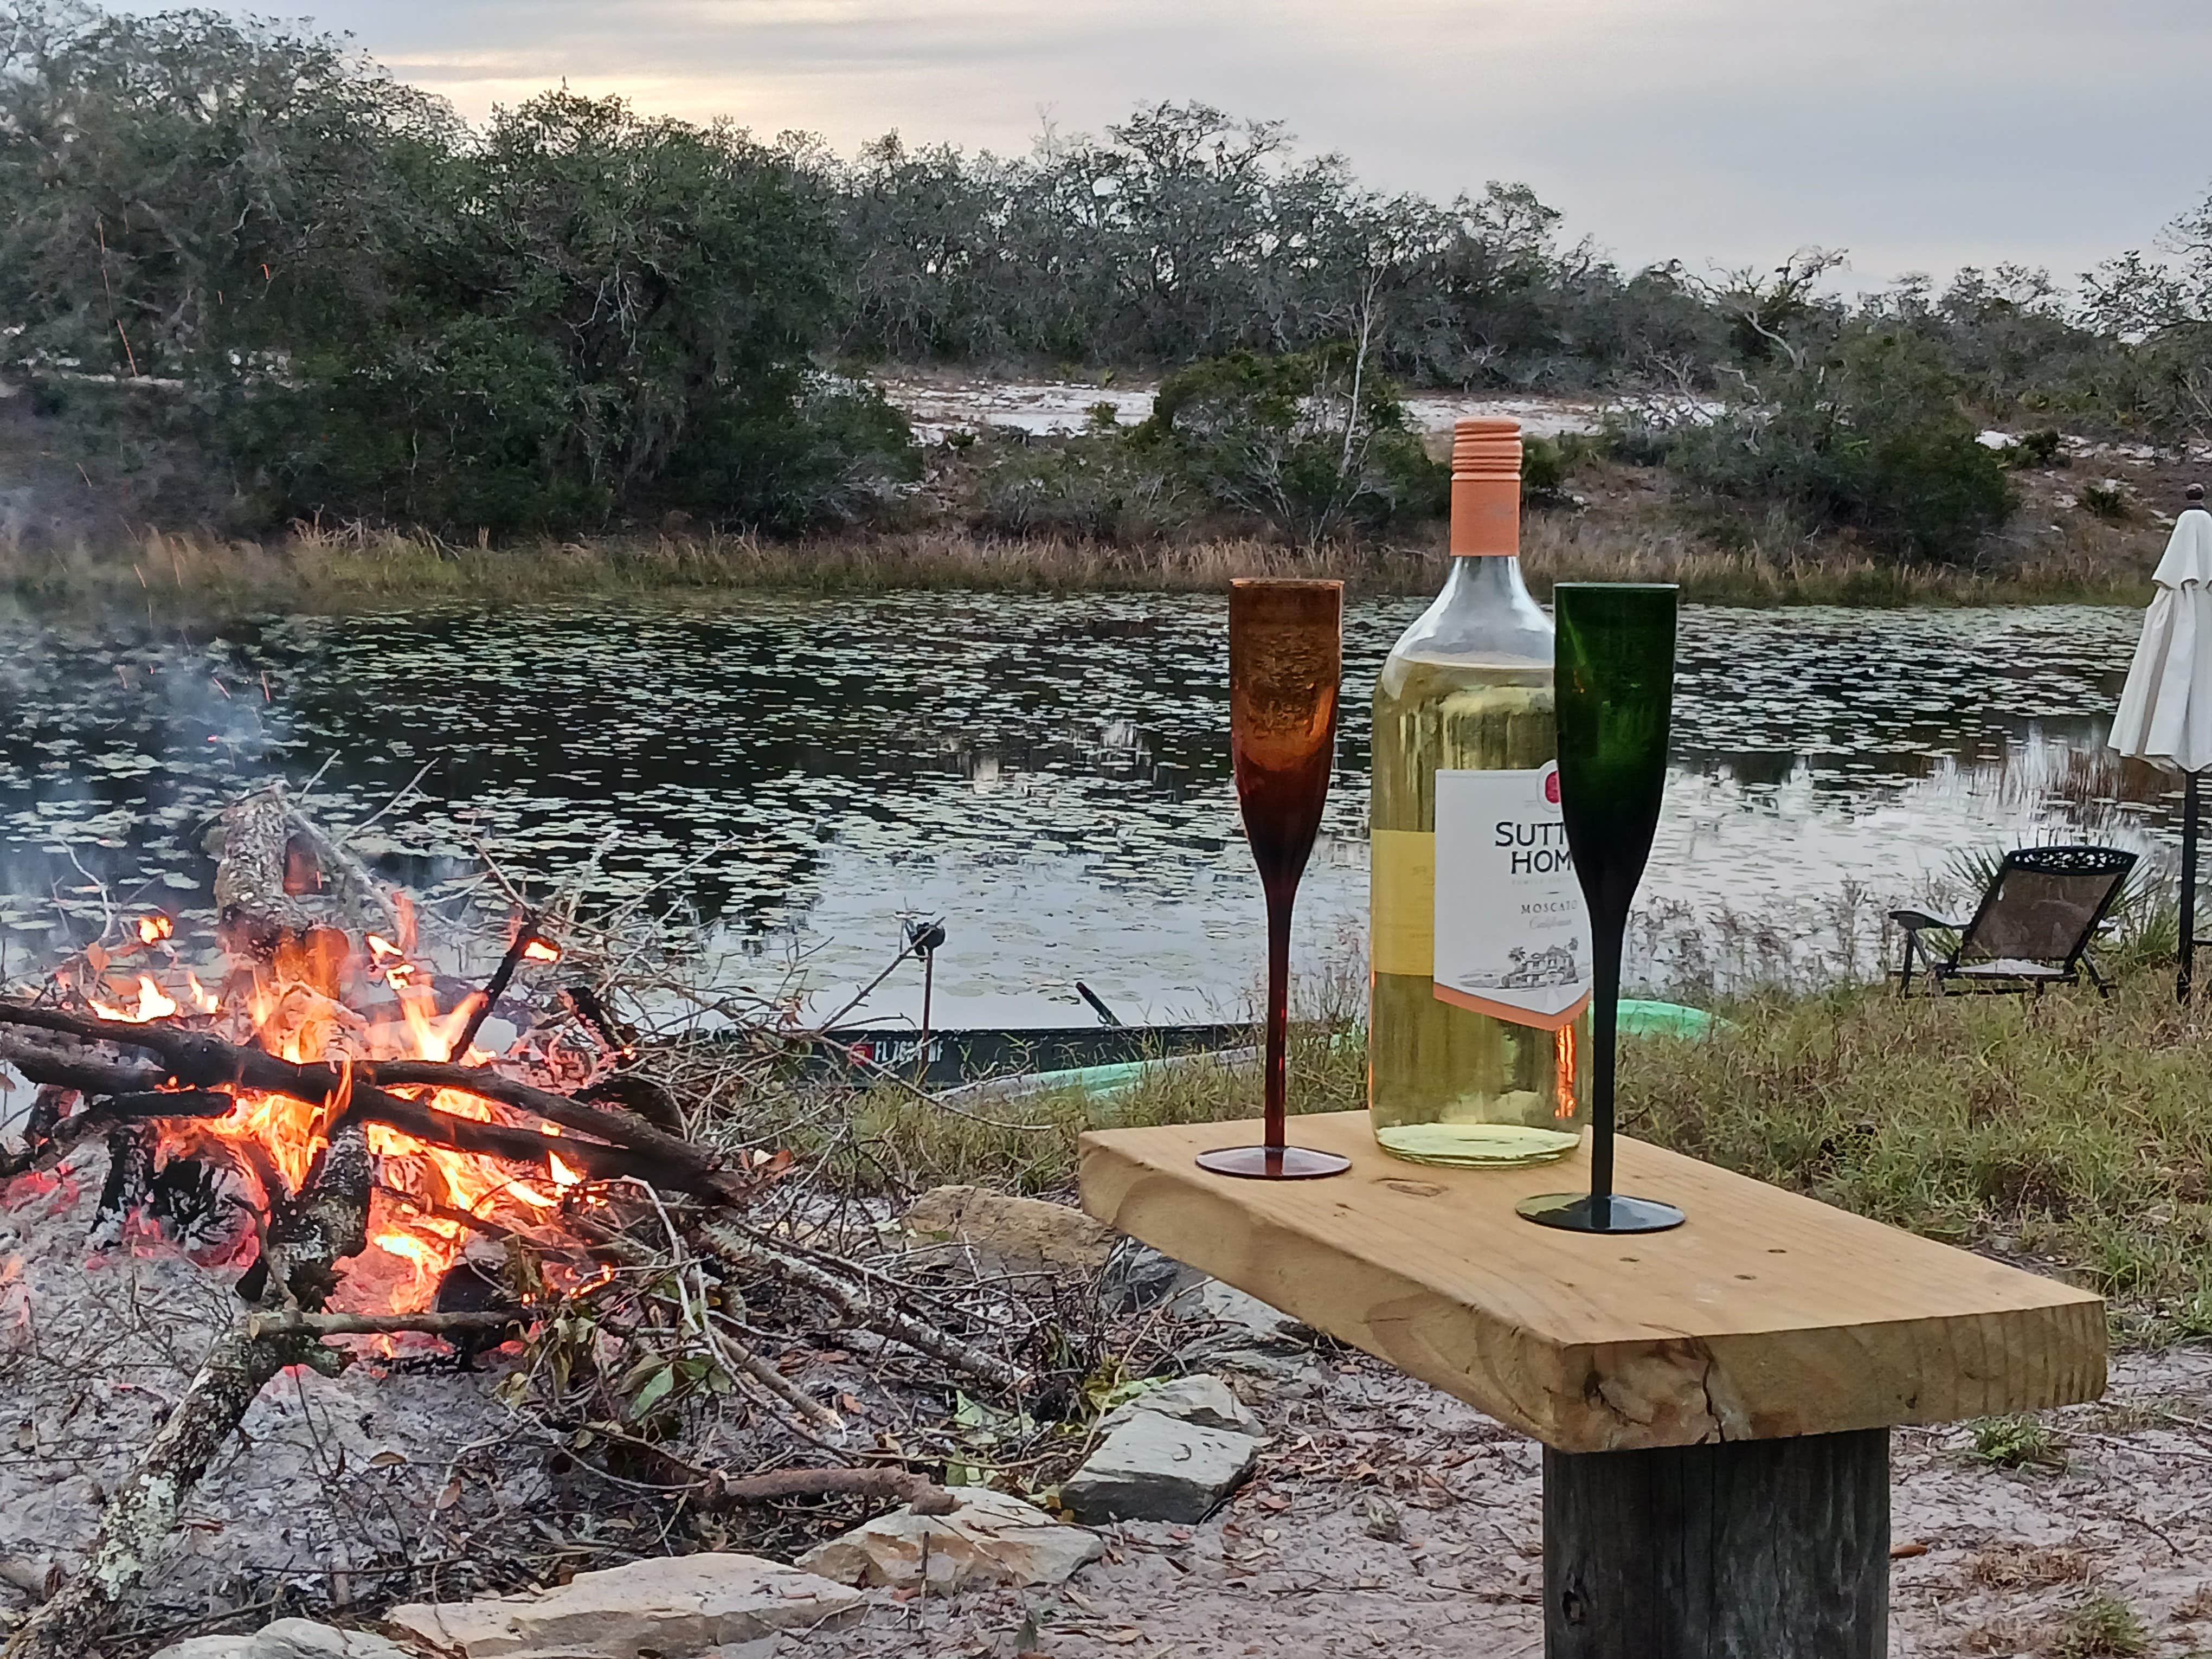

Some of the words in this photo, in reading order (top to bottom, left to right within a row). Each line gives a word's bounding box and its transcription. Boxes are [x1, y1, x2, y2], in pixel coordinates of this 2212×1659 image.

[1495, 821, 1565, 847] SUTT
[1511, 849, 1571, 874] HOM
[1520, 899, 1578, 914] MOSCATO
[874, 1041, 888, 1062] FL
